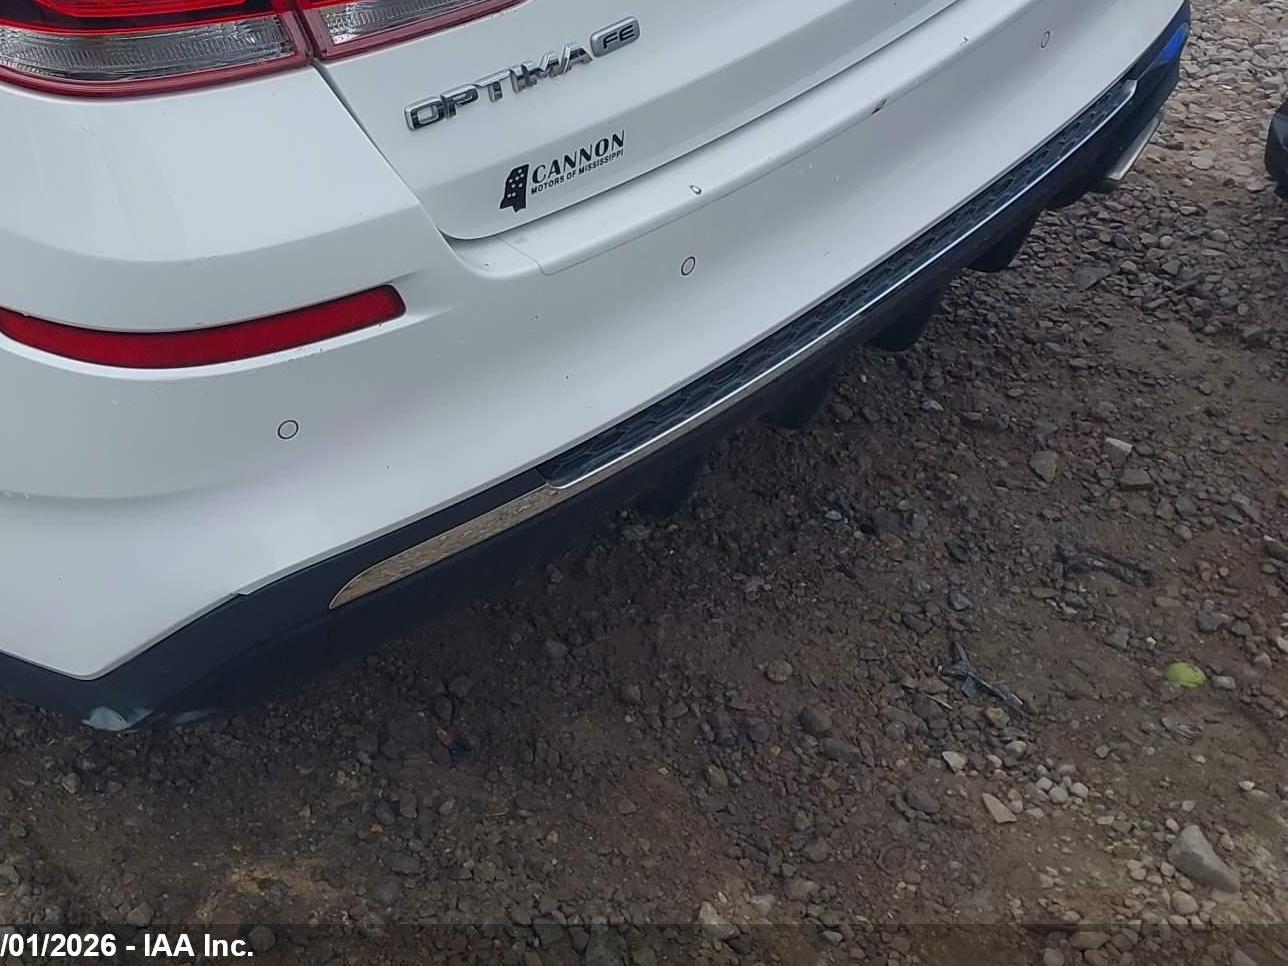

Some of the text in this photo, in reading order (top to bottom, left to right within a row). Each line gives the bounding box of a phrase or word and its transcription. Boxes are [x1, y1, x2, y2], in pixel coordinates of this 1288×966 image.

[404, 23, 636, 131] OPTIMA FE
[531, 149, 624, 195] MOTORS OF MISSISSIPPI
[532, 130, 625, 184] CANNON
